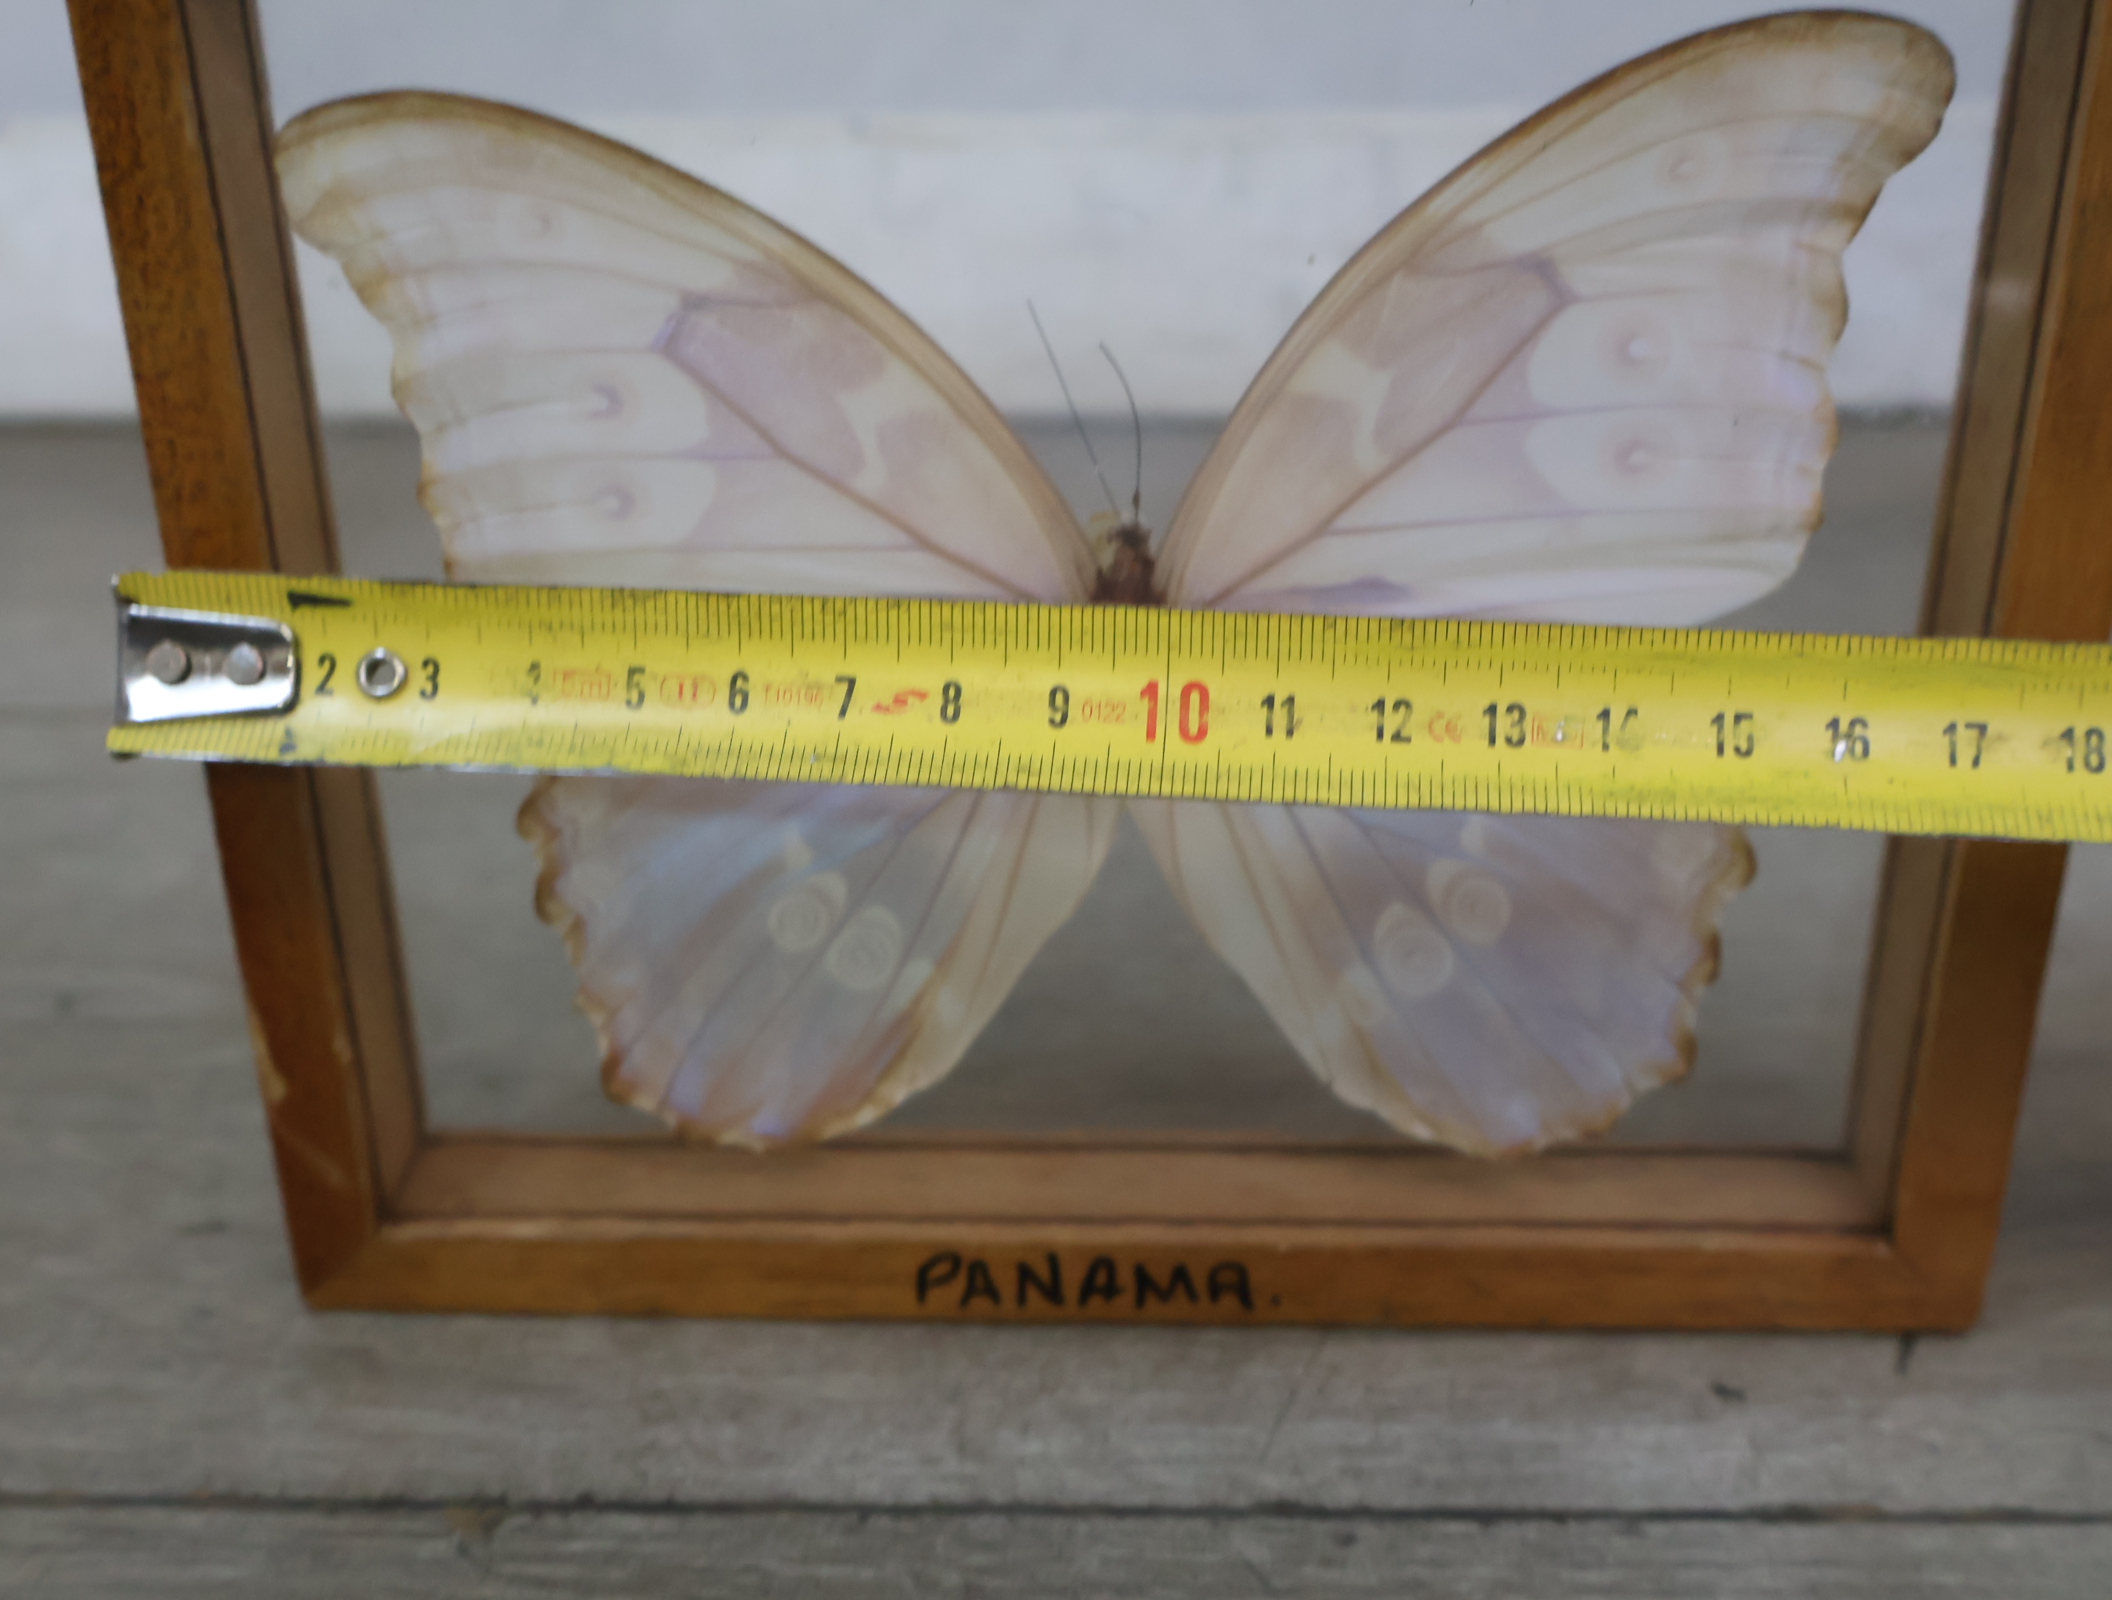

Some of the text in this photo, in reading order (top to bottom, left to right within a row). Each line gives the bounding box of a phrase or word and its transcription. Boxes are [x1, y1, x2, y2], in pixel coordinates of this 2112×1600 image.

[315, 652, 337, 696] 2
[420, 657, 440, 699] 3
[625, 665, 646, 710] 5
[728, 669, 750, 715] 6
[835, 674, 857, 721] 7
[940, 680, 962, 725] 8
[1048, 684, 1070, 728] 9
[1140, 679, 1210, 744] 10
[1260, 693, 1296, 739] 11
[1371, 697, 1413, 743] 12
[1483, 701, 1527, 748] 13
[1710, 711, 1755, 758] 15
[1825, 716, 1870, 762] 16
[1943, 721, 1988, 769] 17
[2060, 726, 2106, 774] 18
